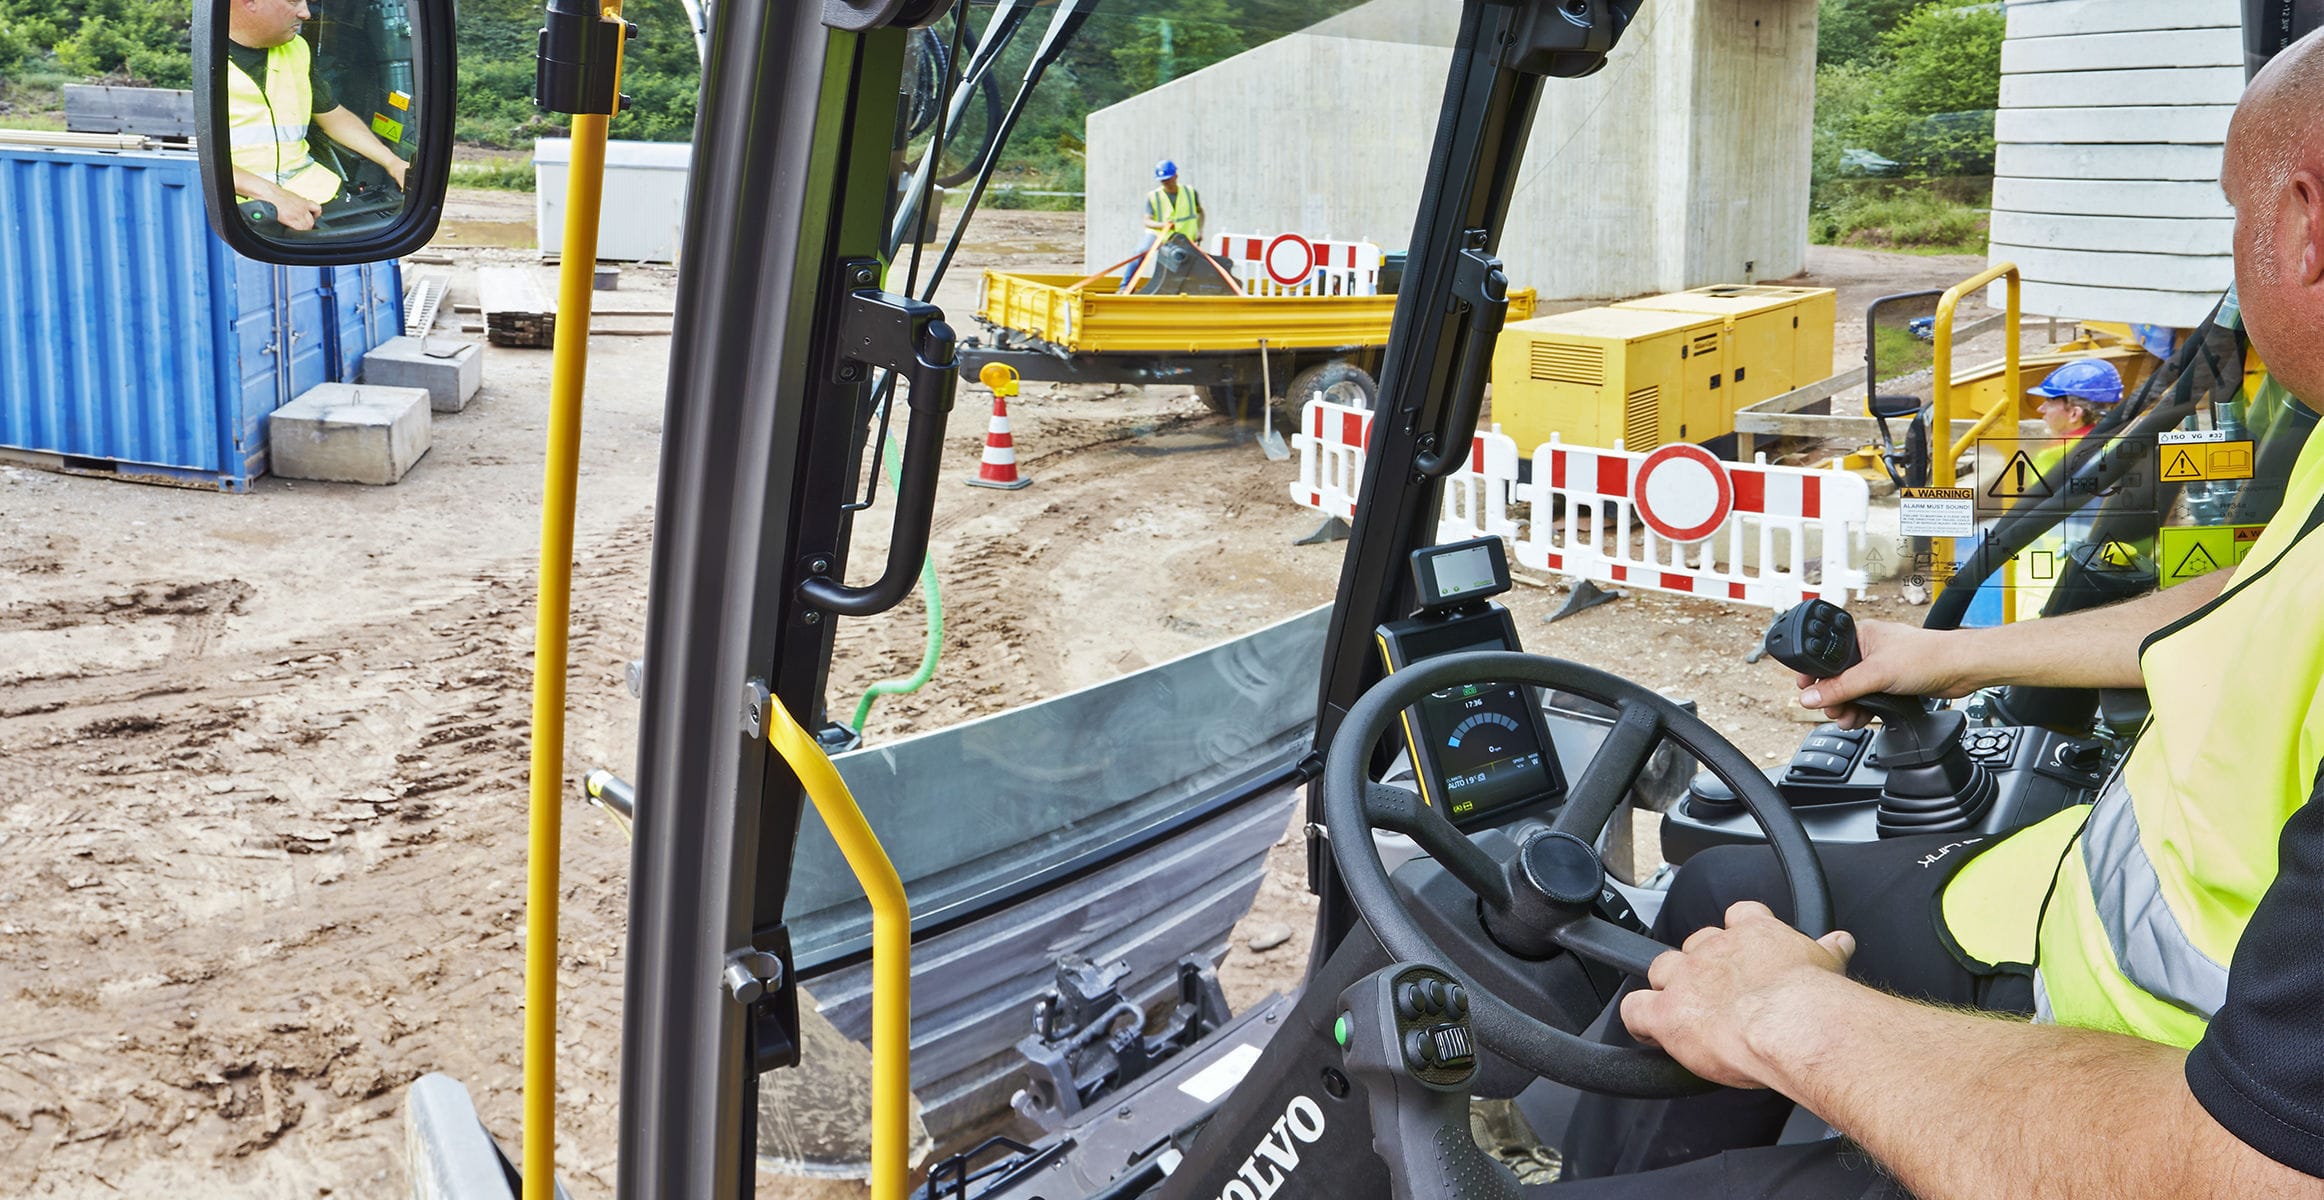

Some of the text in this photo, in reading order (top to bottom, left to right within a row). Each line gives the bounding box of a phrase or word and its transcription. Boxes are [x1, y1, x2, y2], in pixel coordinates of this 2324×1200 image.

[1918, 489, 1970, 498] WARNING
[1448, 779, 1465, 790] AUTO
[1216, 1095, 1325, 1200] LVO
